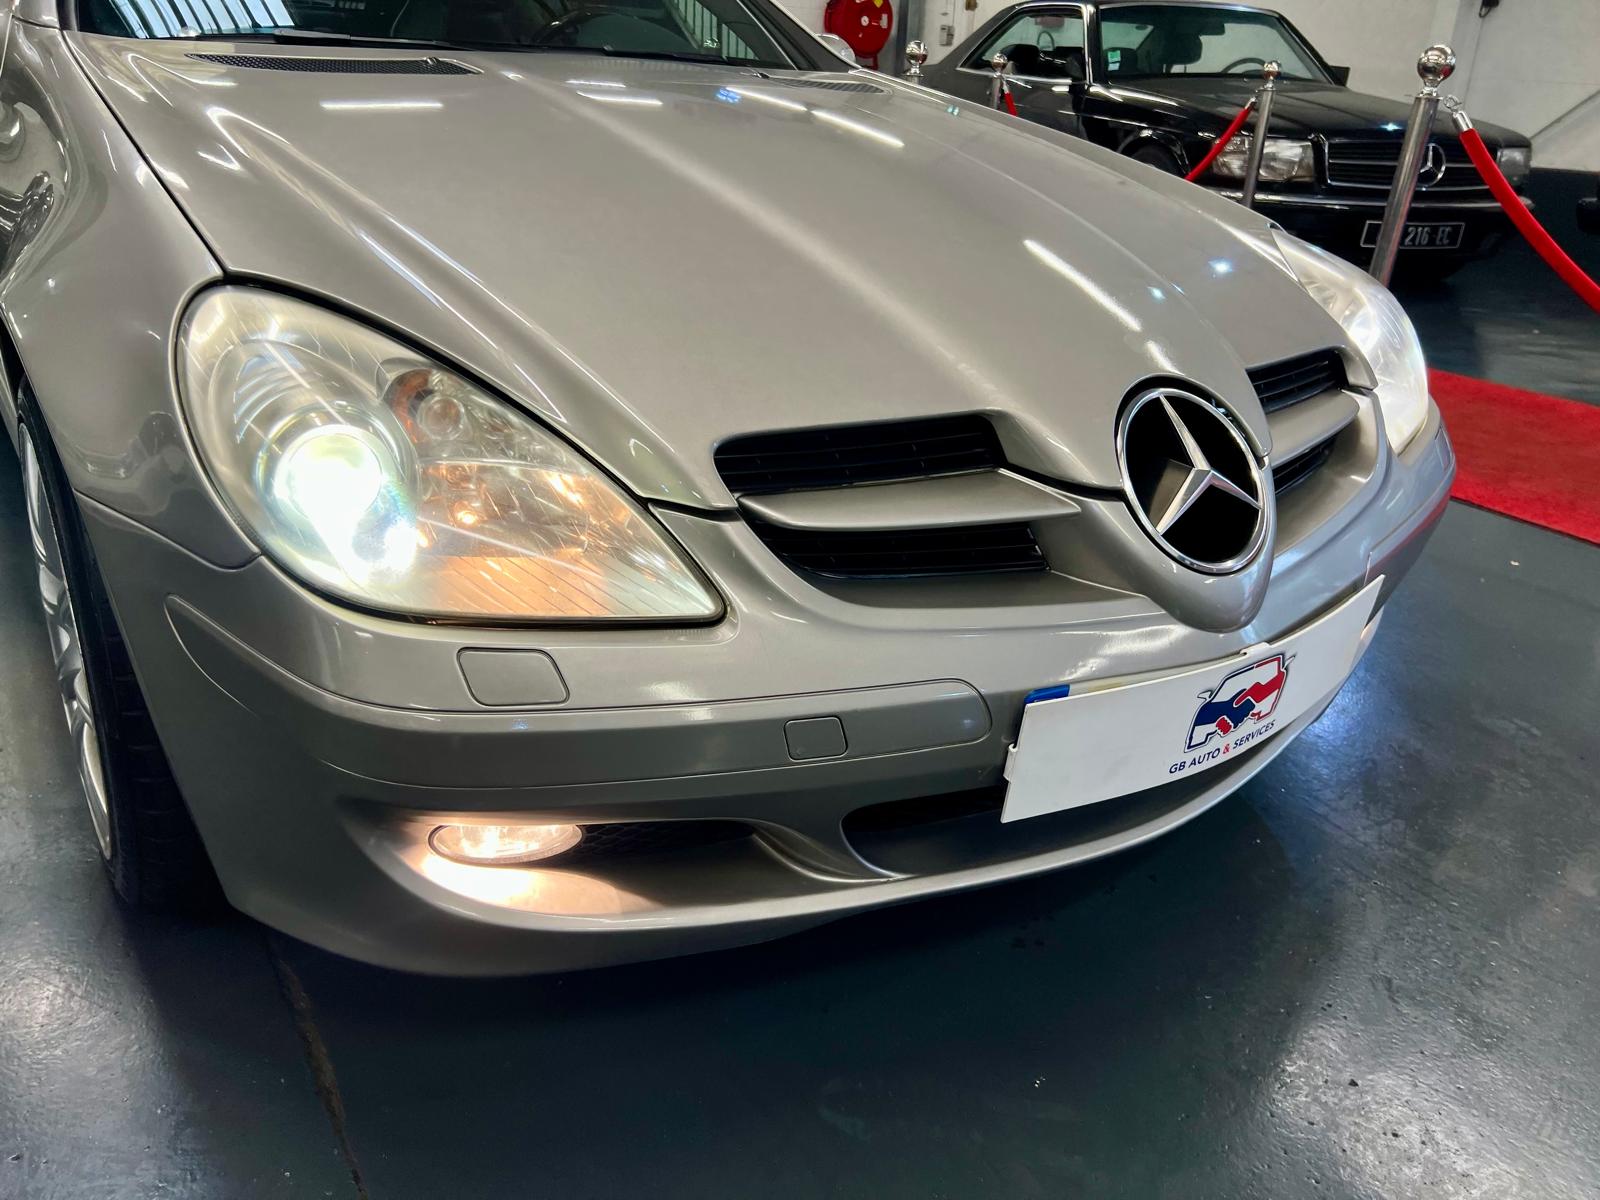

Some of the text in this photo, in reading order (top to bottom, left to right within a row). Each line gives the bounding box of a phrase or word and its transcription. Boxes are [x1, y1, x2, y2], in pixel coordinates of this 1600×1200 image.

[1169, 720, 1276, 774] GB AUTO & SERVICES
